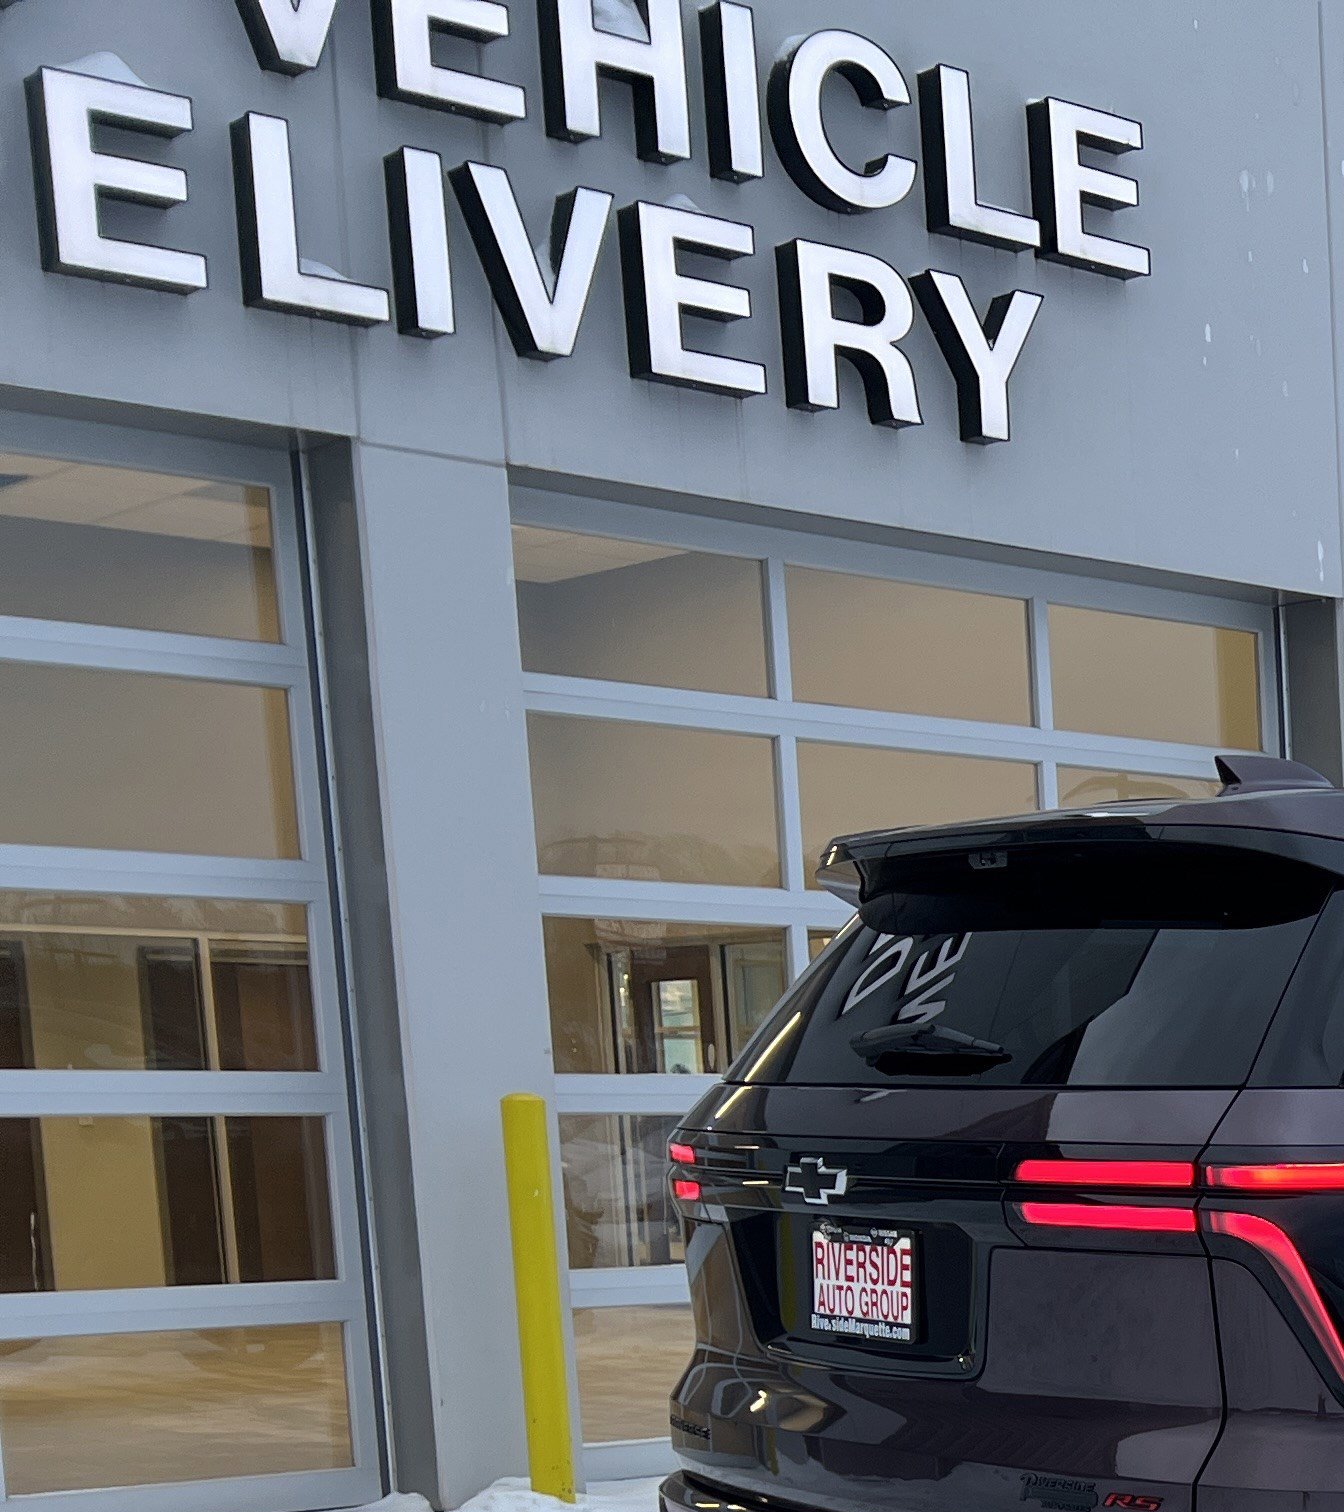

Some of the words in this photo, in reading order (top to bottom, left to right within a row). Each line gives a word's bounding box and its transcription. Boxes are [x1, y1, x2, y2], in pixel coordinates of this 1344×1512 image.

[23, 64, 1043, 444] ELIVERY
[815, 1241, 912, 1288] RIVERSIDE
[818, 1283, 855, 1316] AUTO
[859, 1287, 909, 1321] GROUP
[811, 1314, 910, 1340] RivesideMarquette.com
[1103, 1492, 1164, 1511] RS
